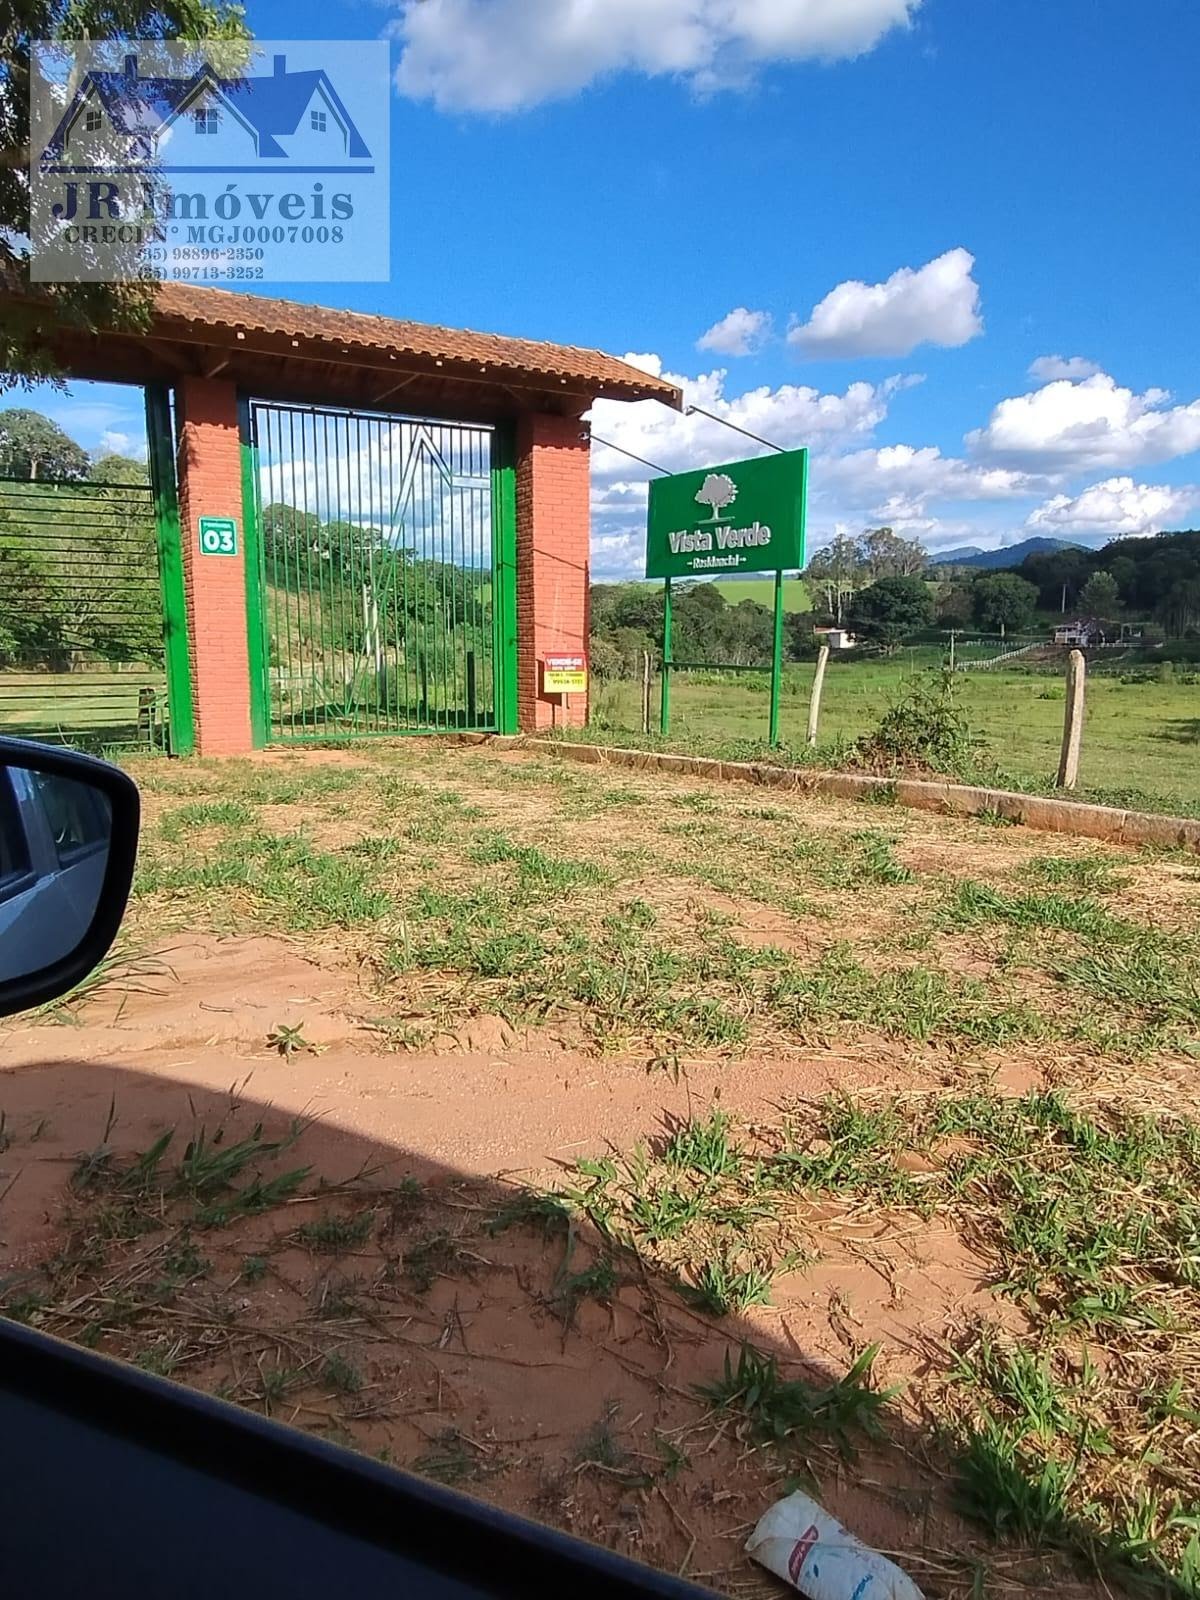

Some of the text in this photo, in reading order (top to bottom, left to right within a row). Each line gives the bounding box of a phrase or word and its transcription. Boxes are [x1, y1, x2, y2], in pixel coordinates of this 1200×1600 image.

[203, 529, 234, 551] 03
[668, 521, 772, 554] Vista Verde
